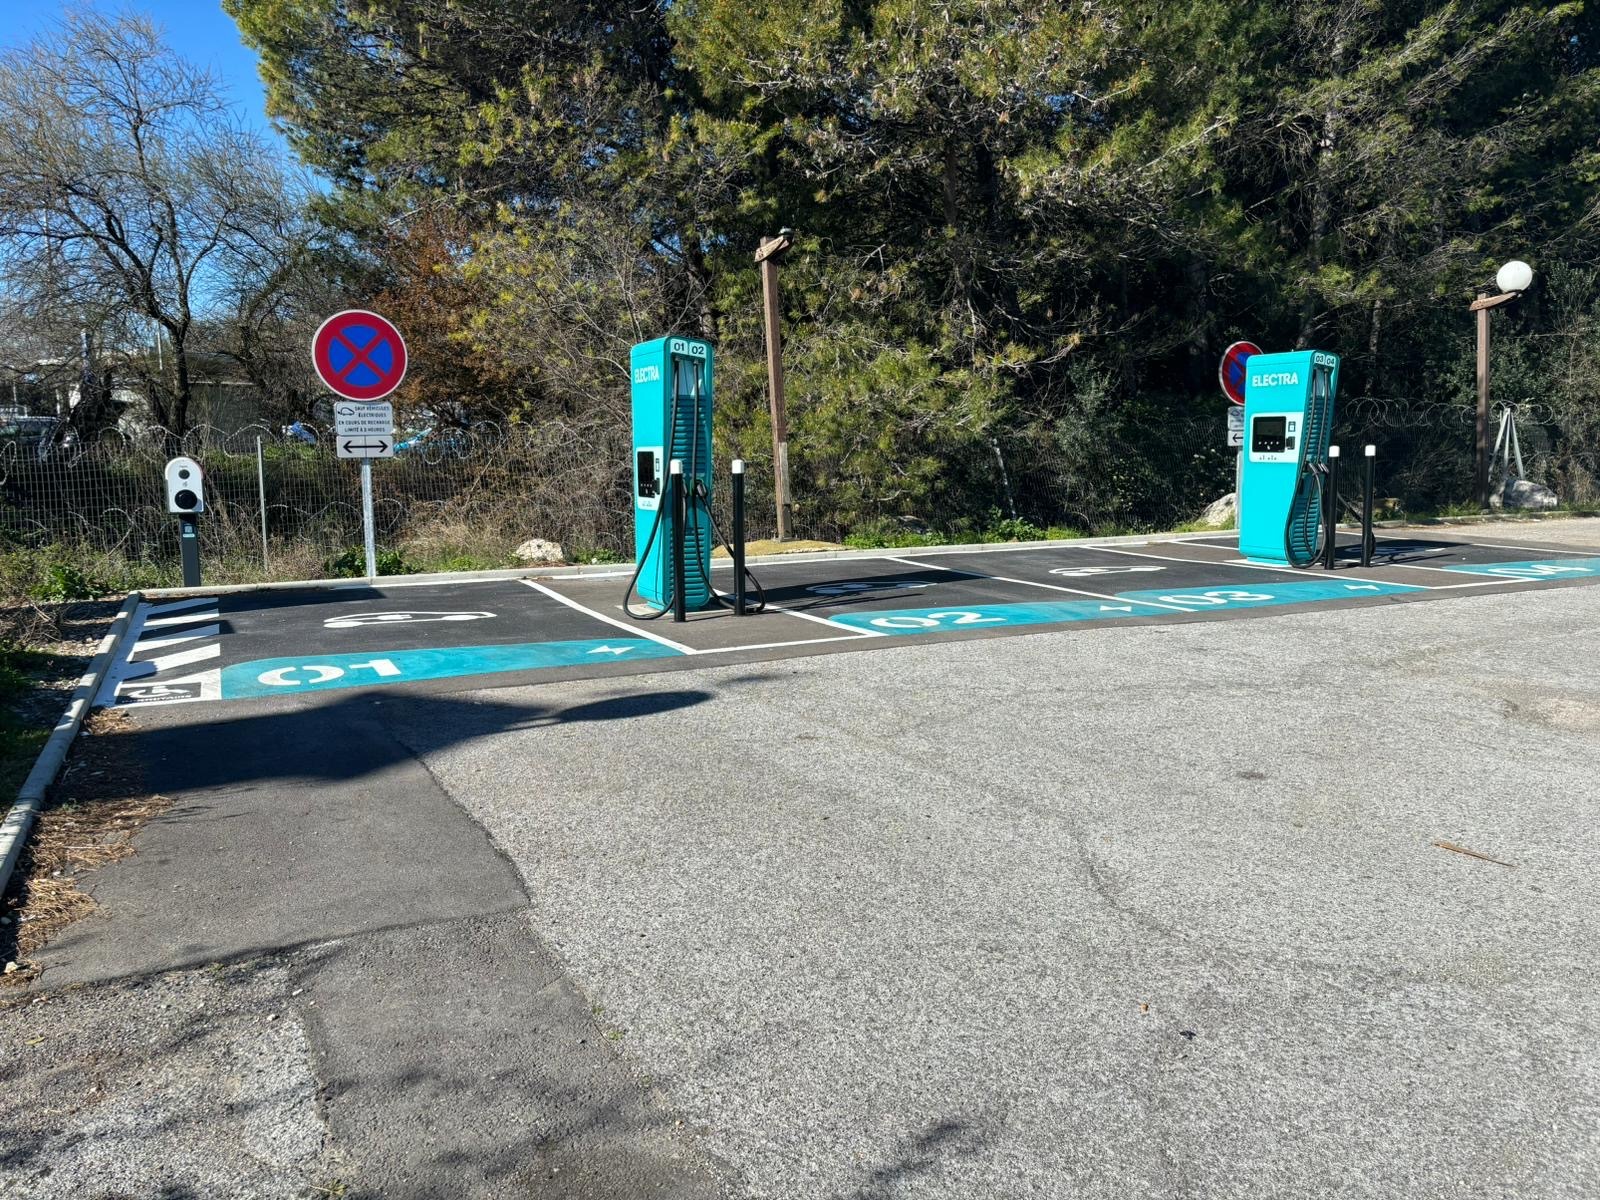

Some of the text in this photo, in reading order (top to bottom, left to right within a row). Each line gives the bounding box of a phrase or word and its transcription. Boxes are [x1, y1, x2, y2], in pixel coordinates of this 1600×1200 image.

[674, 342, 685, 352] 01
[691, 345, 704, 355] 02
[1315, 355, 1324, 363] 03
[1326, 357, 1335, 365] 04
[634, 365, 659, 384] ELECTRA
[1252, 372, 1299, 387] ELECTRA
[1158, 590, 1275, 604] 03
[869, 611, 1007, 628] 02
[257, 658, 402, 686] 01
